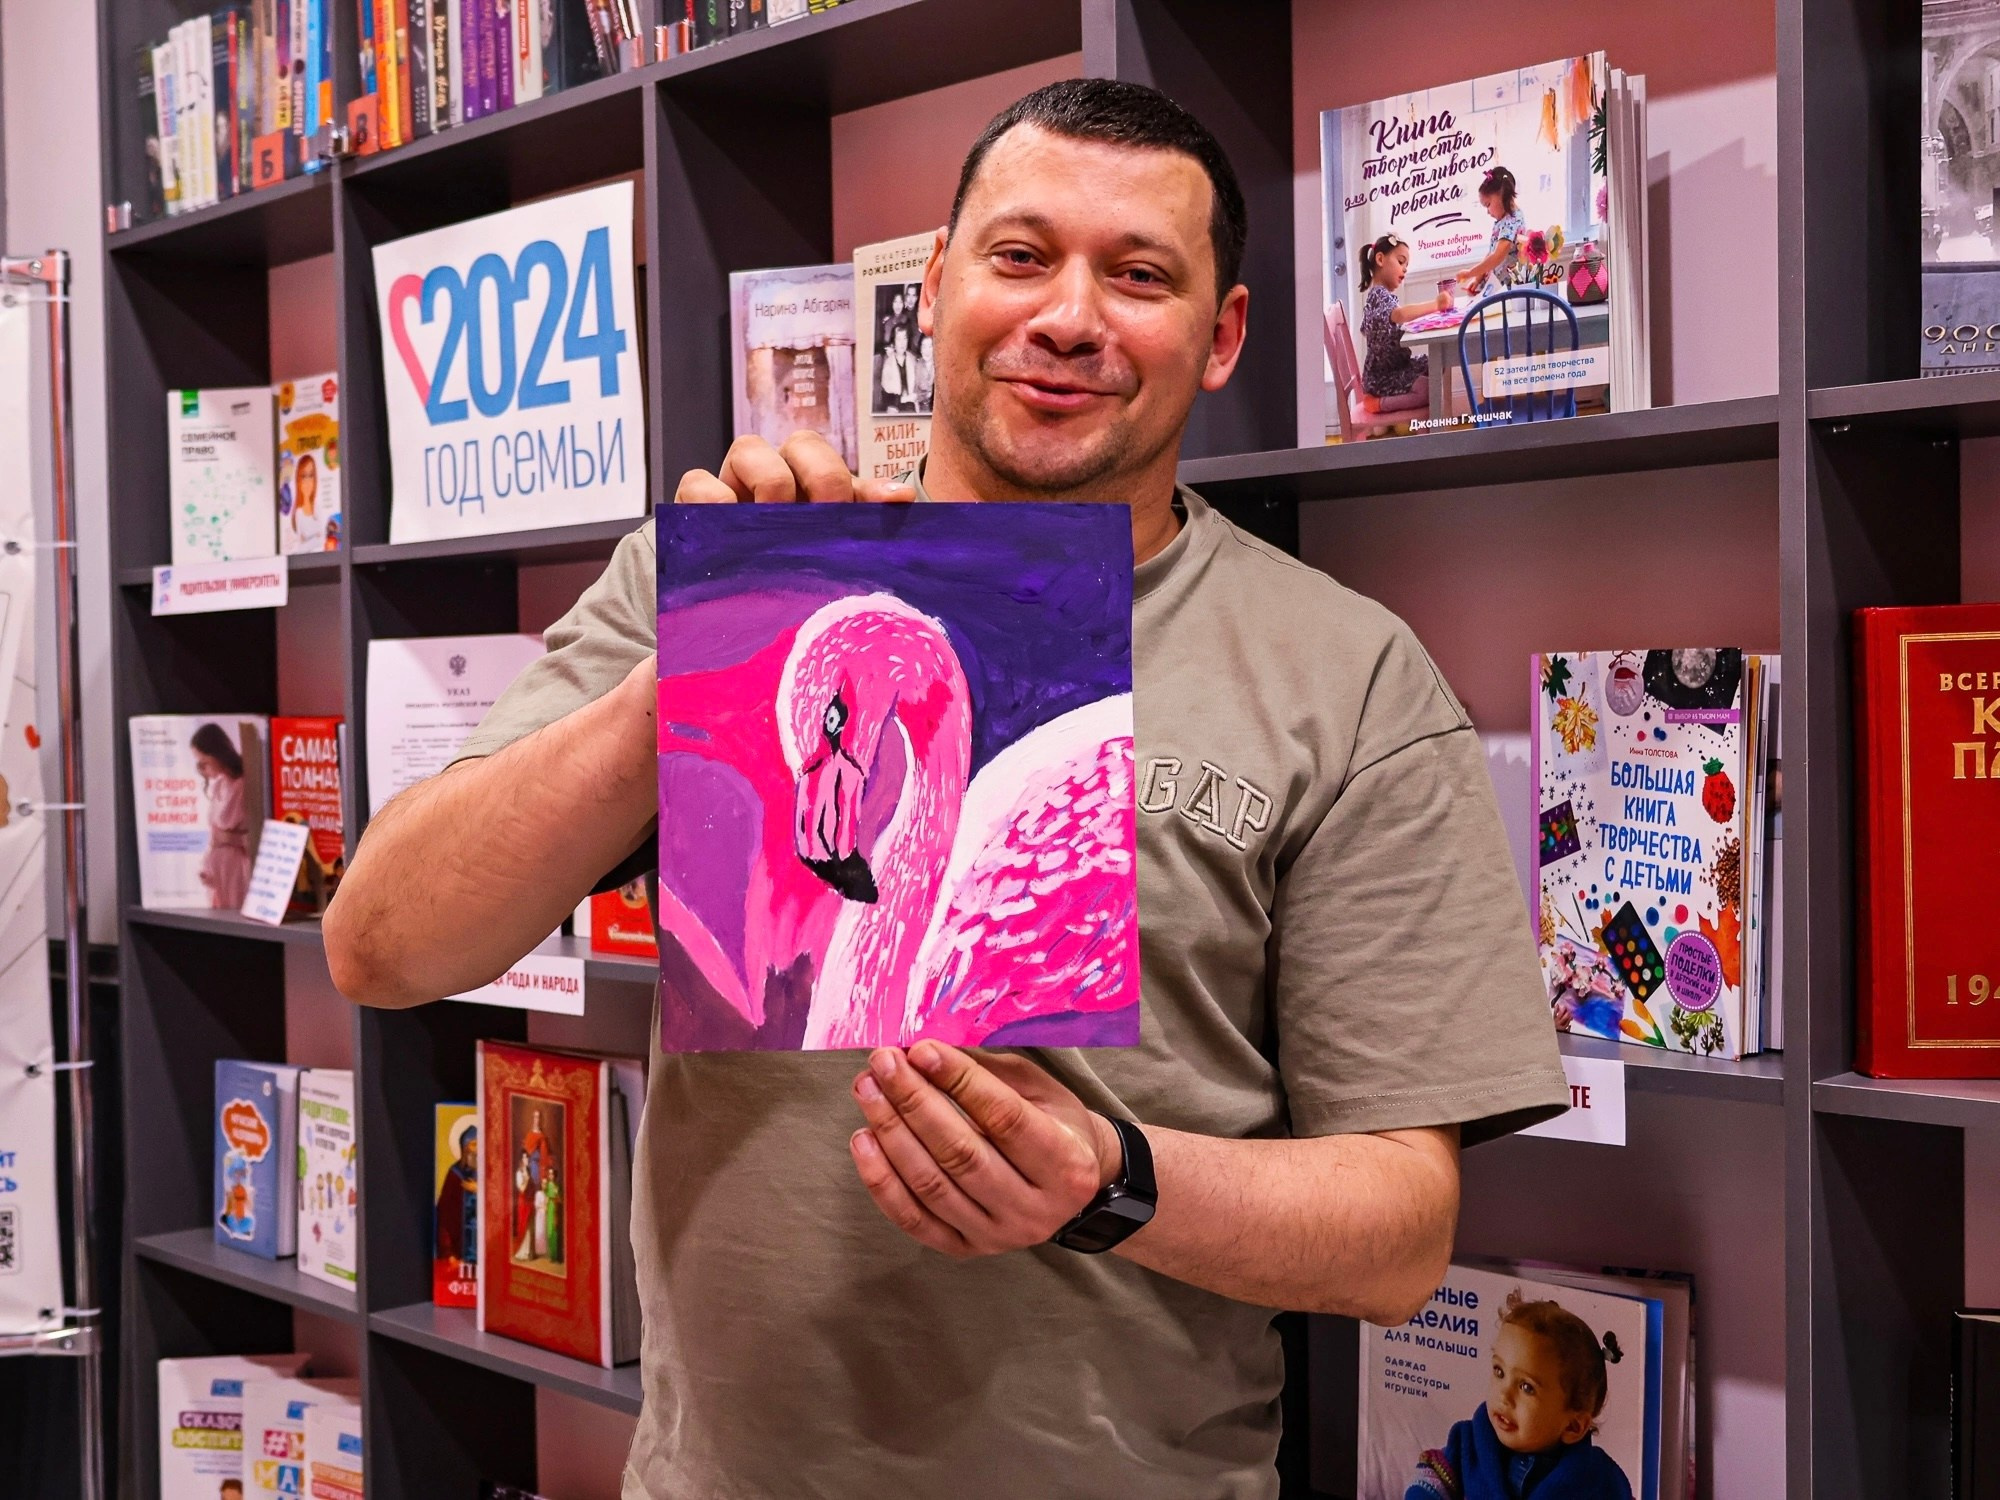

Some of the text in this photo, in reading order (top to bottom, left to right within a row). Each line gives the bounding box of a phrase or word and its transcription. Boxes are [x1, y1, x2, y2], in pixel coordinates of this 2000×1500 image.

[1368, 110, 1456, 153] Книга
[260, 148, 274, 179] Б
[1361, 130, 1475, 180] творчества
[1344, 146, 1494, 212] для счастливого
[1390, 180, 1463, 225] ребенка
[1417, 232, 1483, 251] Учимся говорить
[1430, 244, 1472, 261] «спасибо!»
[754, 298, 850, 319] Наринэ Абгарян
[420, 225, 627, 427] 2024
[1494, 356, 1595, 376] 52 затеи для творчества
[1513, 377, 1528, 385] все
[1529, 373, 1565, 385] времена
[1567, 370, 1587, 380] года
[874, 423, 920, 442] ЖИЛИ-
[1409, 410, 1513, 432] Джоанна Гжешчак
[886, 440, 926, 460] БЫЛИ
[447, 688, 471, 696] УКАЗ
[1629, 747, 1678, 759] Инна ТОЛСТОВА
[1611, 761, 1695, 797] БОЛЬШАЯ
[1138, 757, 1274, 851] GAP
[1624, 795, 1676, 826] КНИГА
[1599, 823, 1702, 864] ТВОРЧЕСТВА
[1604, 856, 1693, 895] С ДЕТЬМИ
[1679, 942, 1712, 965] ПРОСТЫЕ
[1671, 953, 1715, 983] ПОДЕЛКИ
[507, 971, 530, 991] РОДА
[534, 974, 540, 988] И
[542, 975, 580, 997] НАРОДА
[1675, 972, 1699, 988] ДЕТСКИЙ
[1700, 984, 1712, 996] САД
[1681, 987, 1702, 1002] ШКОЛУ
[1569, 1085, 1591, 1109] ТЕ
[1432, 1287, 1479, 1309] ные
[1385, 1329, 1478, 1358] для малыша
[1385, 1356, 1426, 1371] одежда
[1385, 1368, 1450, 1390] аксессуары
[1385, 1381, 1428, 1398] игрушки
